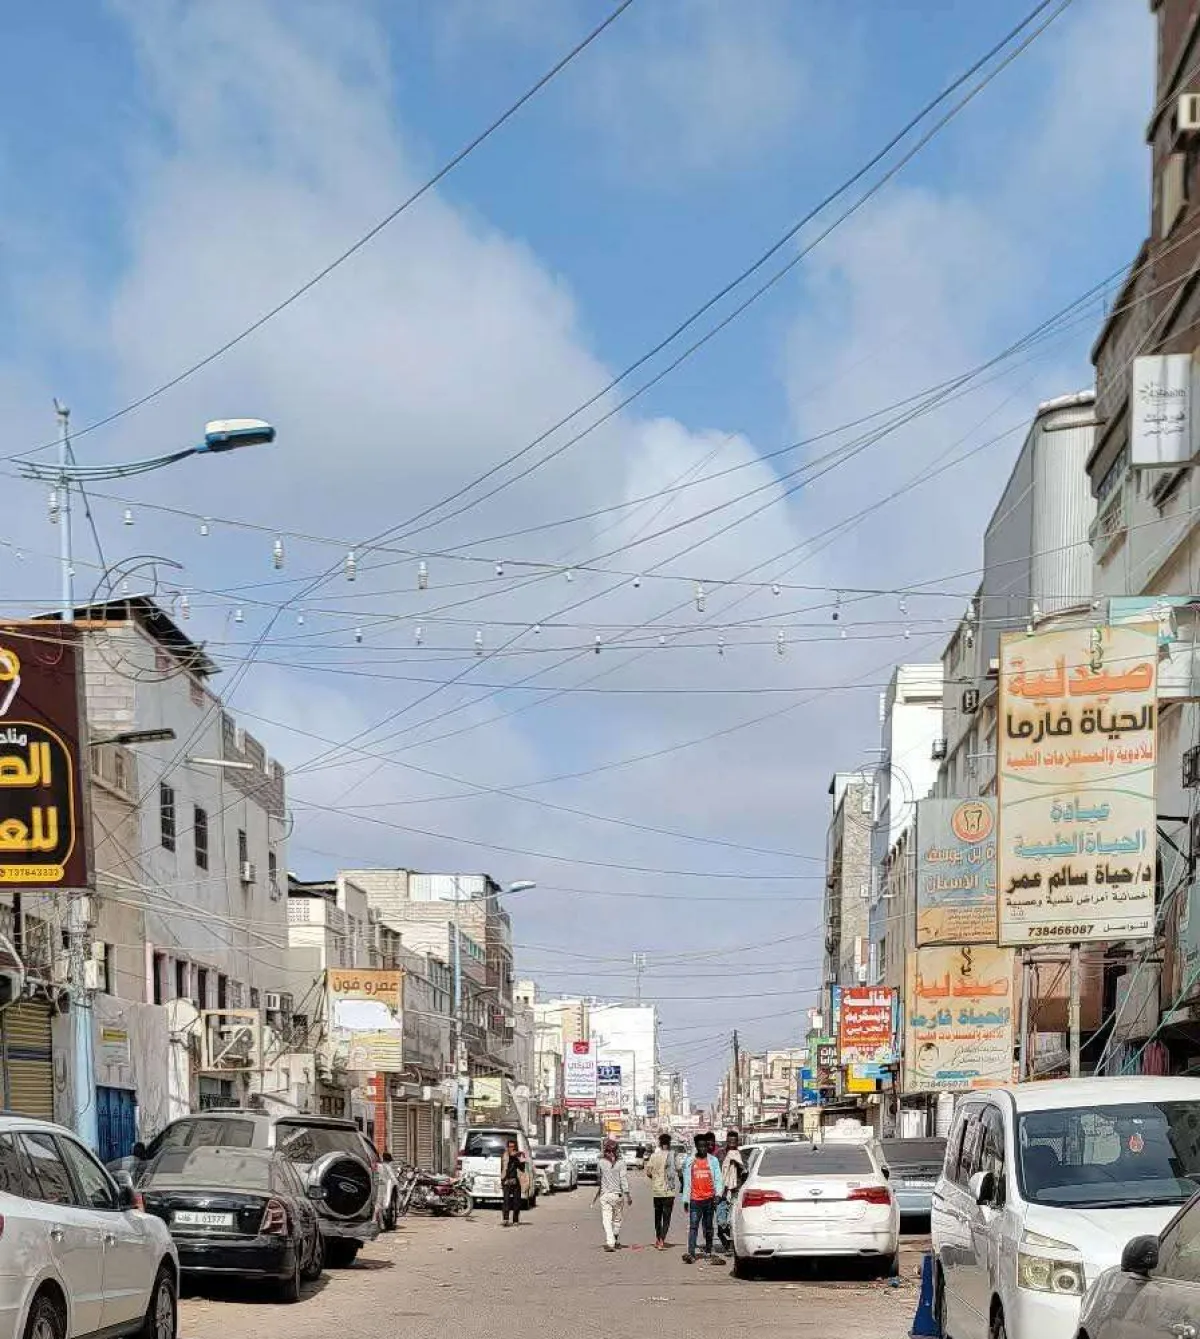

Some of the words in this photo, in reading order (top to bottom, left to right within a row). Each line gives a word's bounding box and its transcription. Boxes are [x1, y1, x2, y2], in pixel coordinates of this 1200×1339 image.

[1007, 654, 1154, 706] صيدلية
[1006, 709, 1073, 744] فارما
[1080, 705, 1154, 740] الحياة
[0, 741, 52, 788] الص
[1050, 796, 1111, 824] عيادة
[0, 806, 58, 852] للع
[1083, 826, 1147, 857] الحياة
[1012, 831, 1083, 861] الطبية
[1006, 871, 1043, 894] عمر
[1048, 864, 1088, 894] سالم
[332, 976, 361, 994] فون
[363, 980, 399, 996] عمرو
[913, 969, 1009, 1004] صيدلية
[910, 1008, 953, 1029] فارما
[958, 1006, 1010, 1028] الحياة
